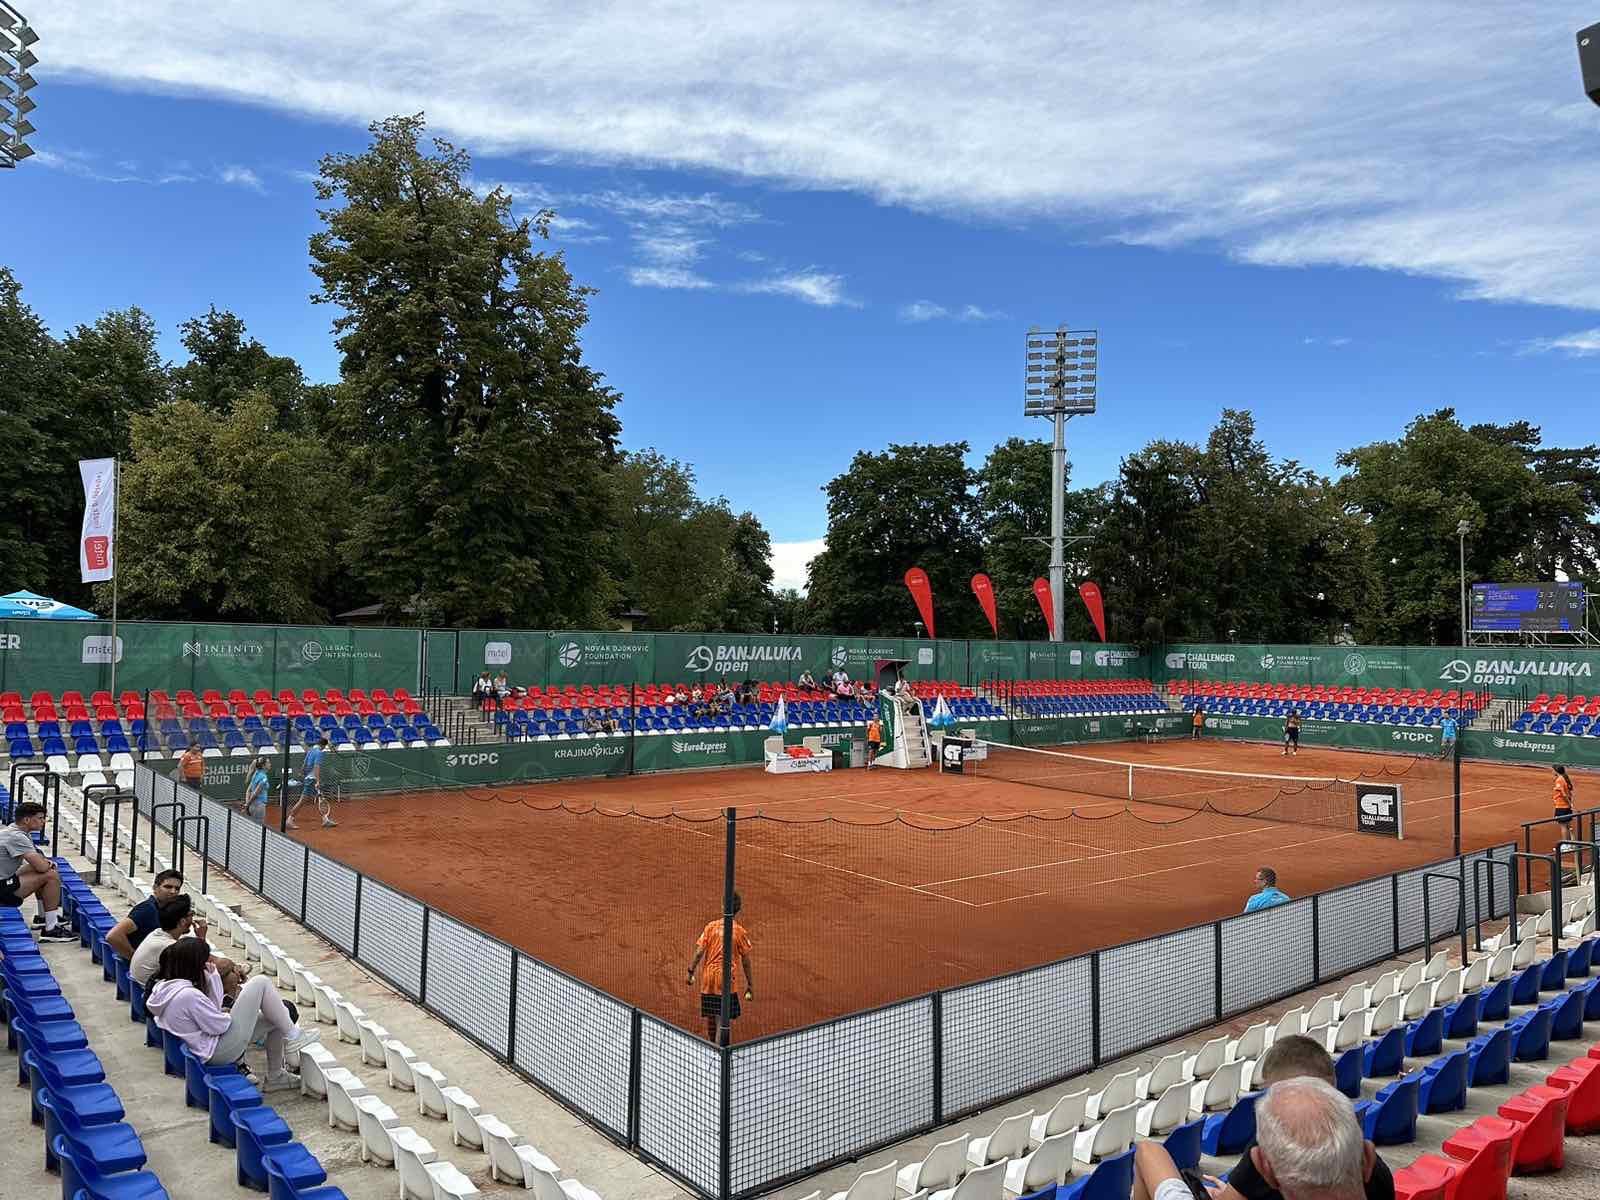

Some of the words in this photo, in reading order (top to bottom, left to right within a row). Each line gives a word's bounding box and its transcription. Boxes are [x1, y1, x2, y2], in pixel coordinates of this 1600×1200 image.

[87, 645, 117, 656] m:te
[584, 653, 632, 661] FOUNDATION
[716, 645, 803, 662] BANJALUKA
[1187, 653, 1236, 663] CHALLENGER
[714, 661, 749, 675] open
[1187, 661, 1208, 670] TOUR
[1475, 659, 1592, 677] BANJALUKA
[1473, 673, 1517, 686] open
[1401, 731, 1434, 743] TCPC
[683, 741, 728, 754] EuroExpress
[1504, 739, 1556, 752] EuroExpress
[459, 752, 499, 766] TCPC
[553, 748, 594, 760] KRAJINA
[600, 745, 626, 756] KLAS
[203, 775, 231, 785] TOUR
[1361, 814, 1394, 823] CHALLENGER
